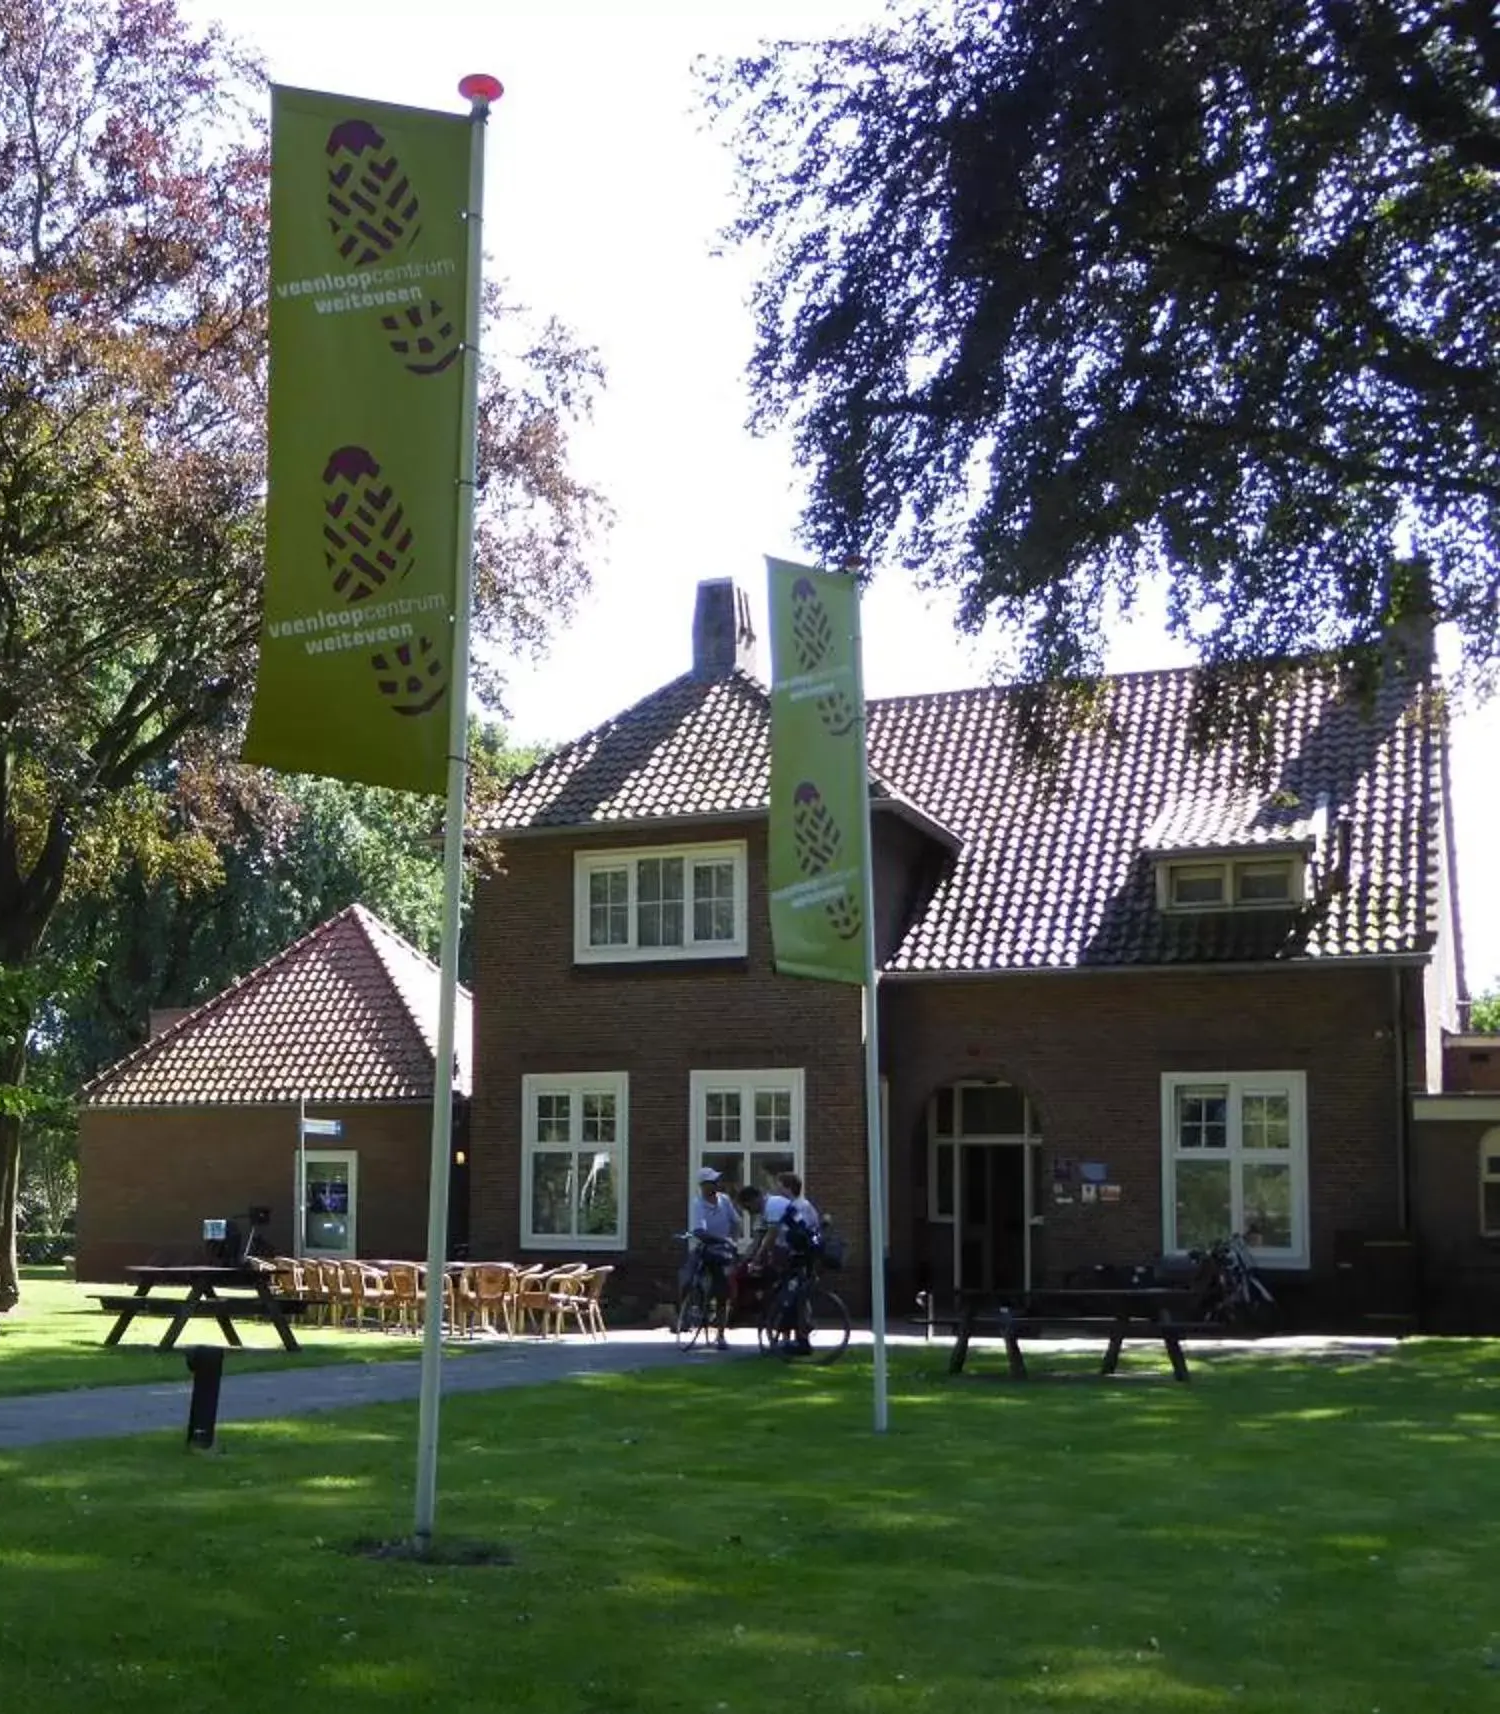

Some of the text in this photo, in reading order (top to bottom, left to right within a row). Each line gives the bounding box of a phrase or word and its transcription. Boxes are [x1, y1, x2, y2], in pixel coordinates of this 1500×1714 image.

[276, 258, 455, 298] veenloopcentrum
[314, 285, 423, 315] weiteveen
[268, 593, 446, 638] veenloopcentrum
[305, 622, 414, 655] weiteveen
